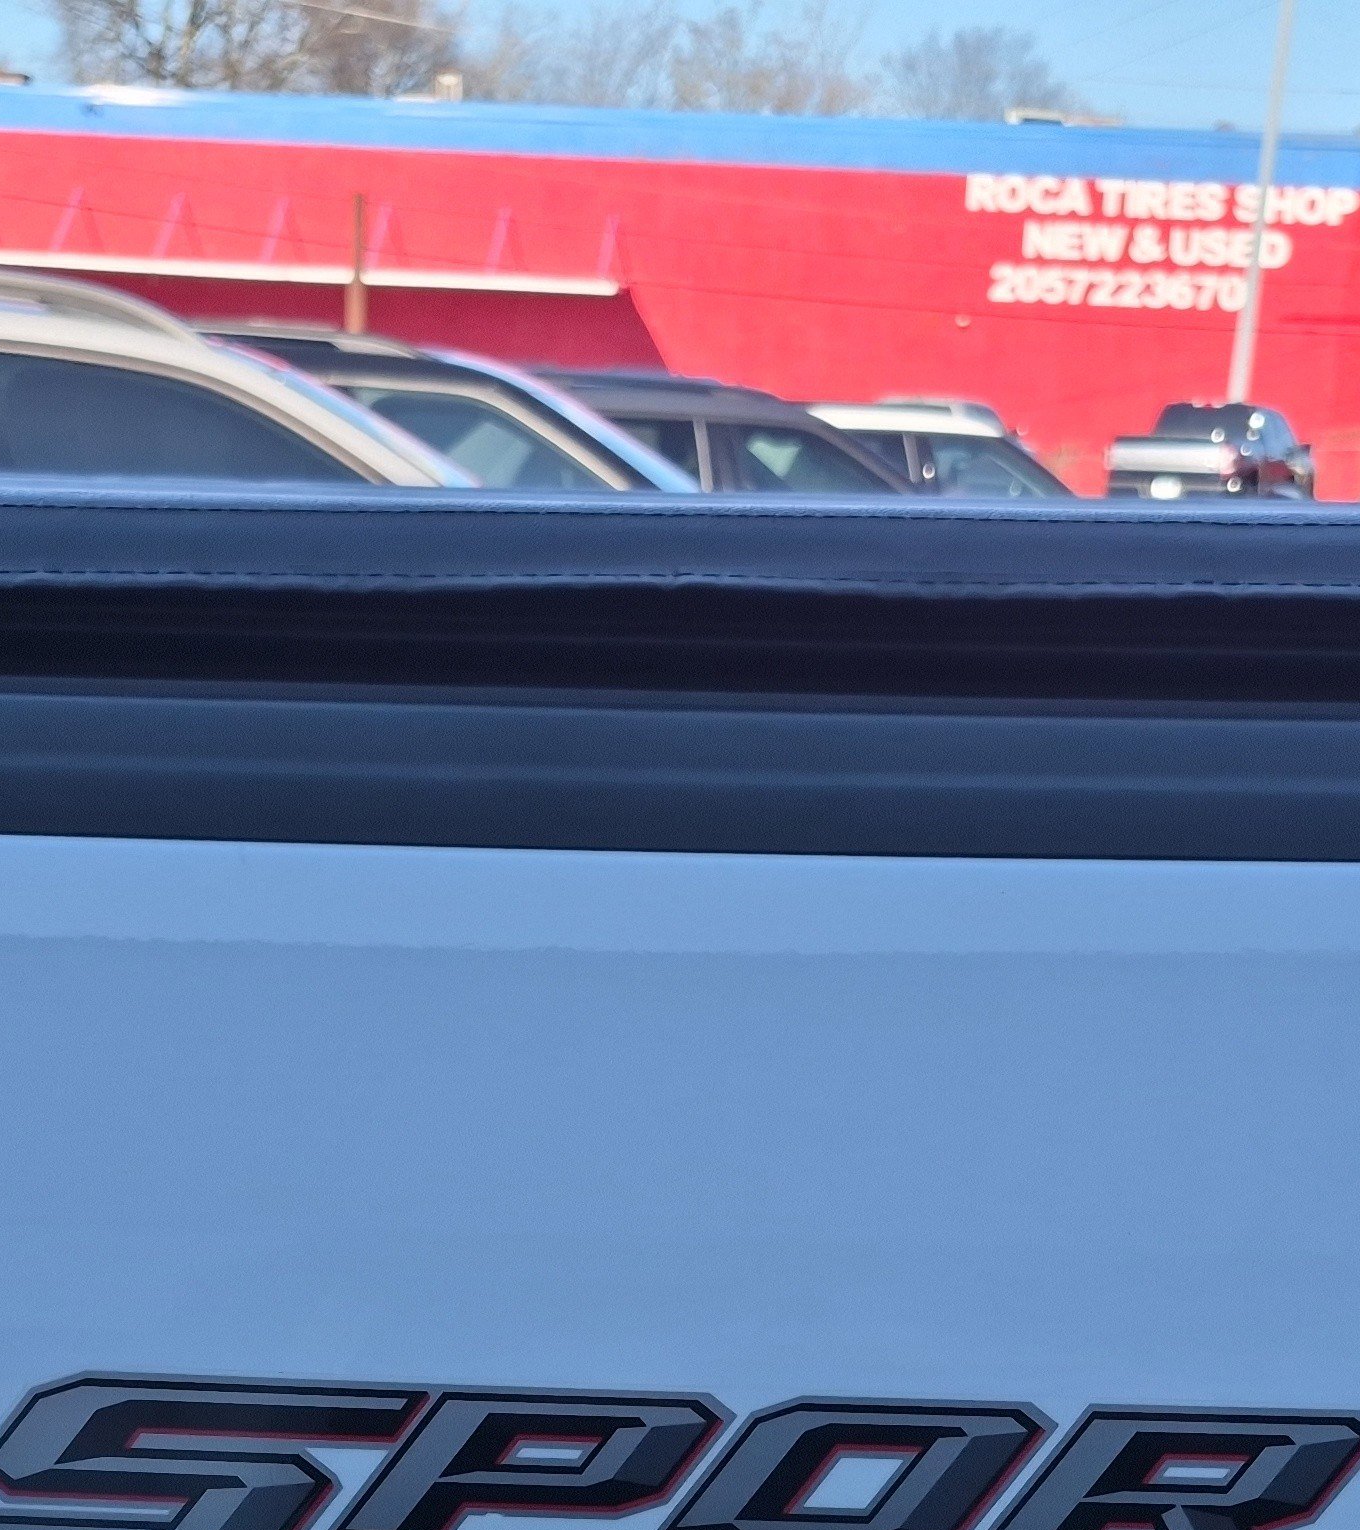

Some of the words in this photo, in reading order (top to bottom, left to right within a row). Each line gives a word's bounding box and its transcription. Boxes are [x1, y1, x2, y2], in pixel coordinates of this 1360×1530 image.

[965, 172, 1093, 217] ROCA
[1094, 177, 1228, 221] TIRES
[1232, 183, 1360, 226] SHOP
[1021, 219, 1128, 263] NEW
[1128, 223, 1167, 264] &
[1168, 227, 1294, 269] USED
